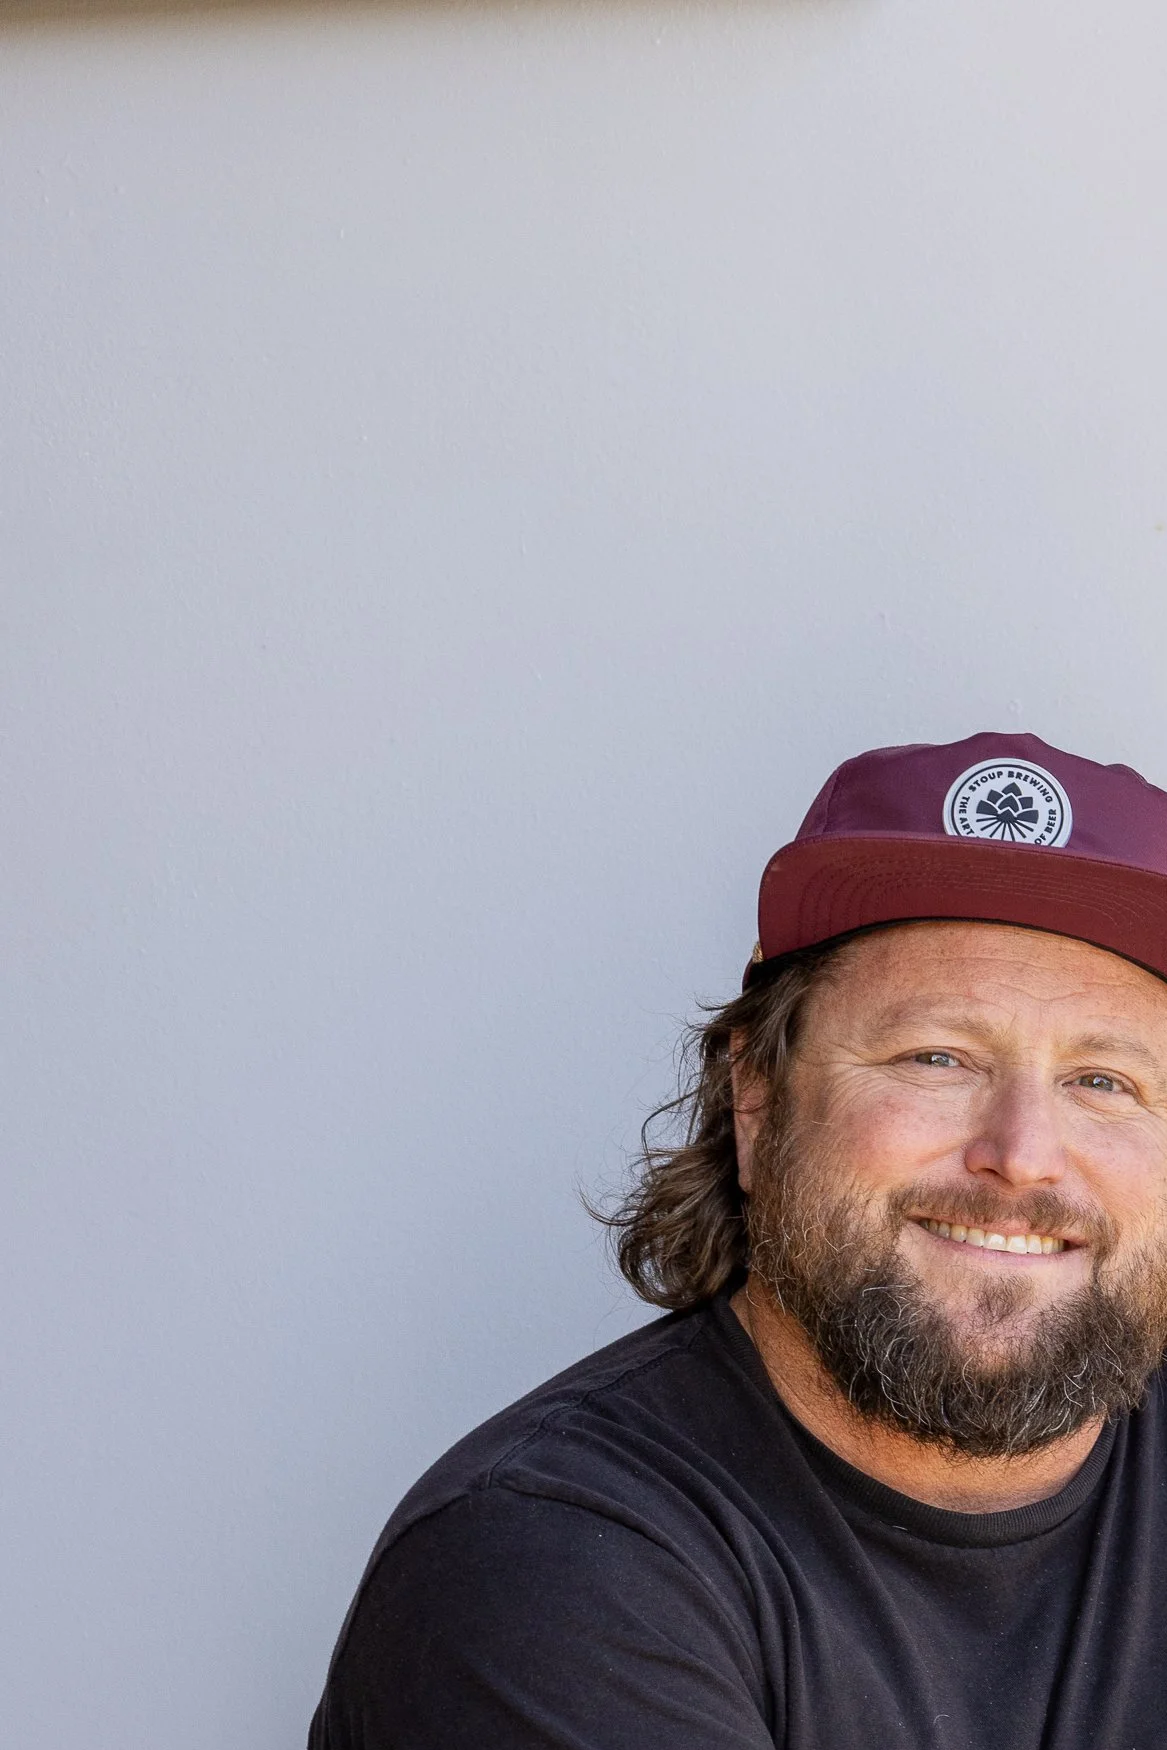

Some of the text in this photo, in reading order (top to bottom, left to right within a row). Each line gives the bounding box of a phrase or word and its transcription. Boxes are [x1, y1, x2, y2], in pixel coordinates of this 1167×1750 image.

[968, 770, 1053, 803] STOUP BREWING
[958, 796, 975, 836] THE ART
[1034, 808, 1057, 845] OF BEER
